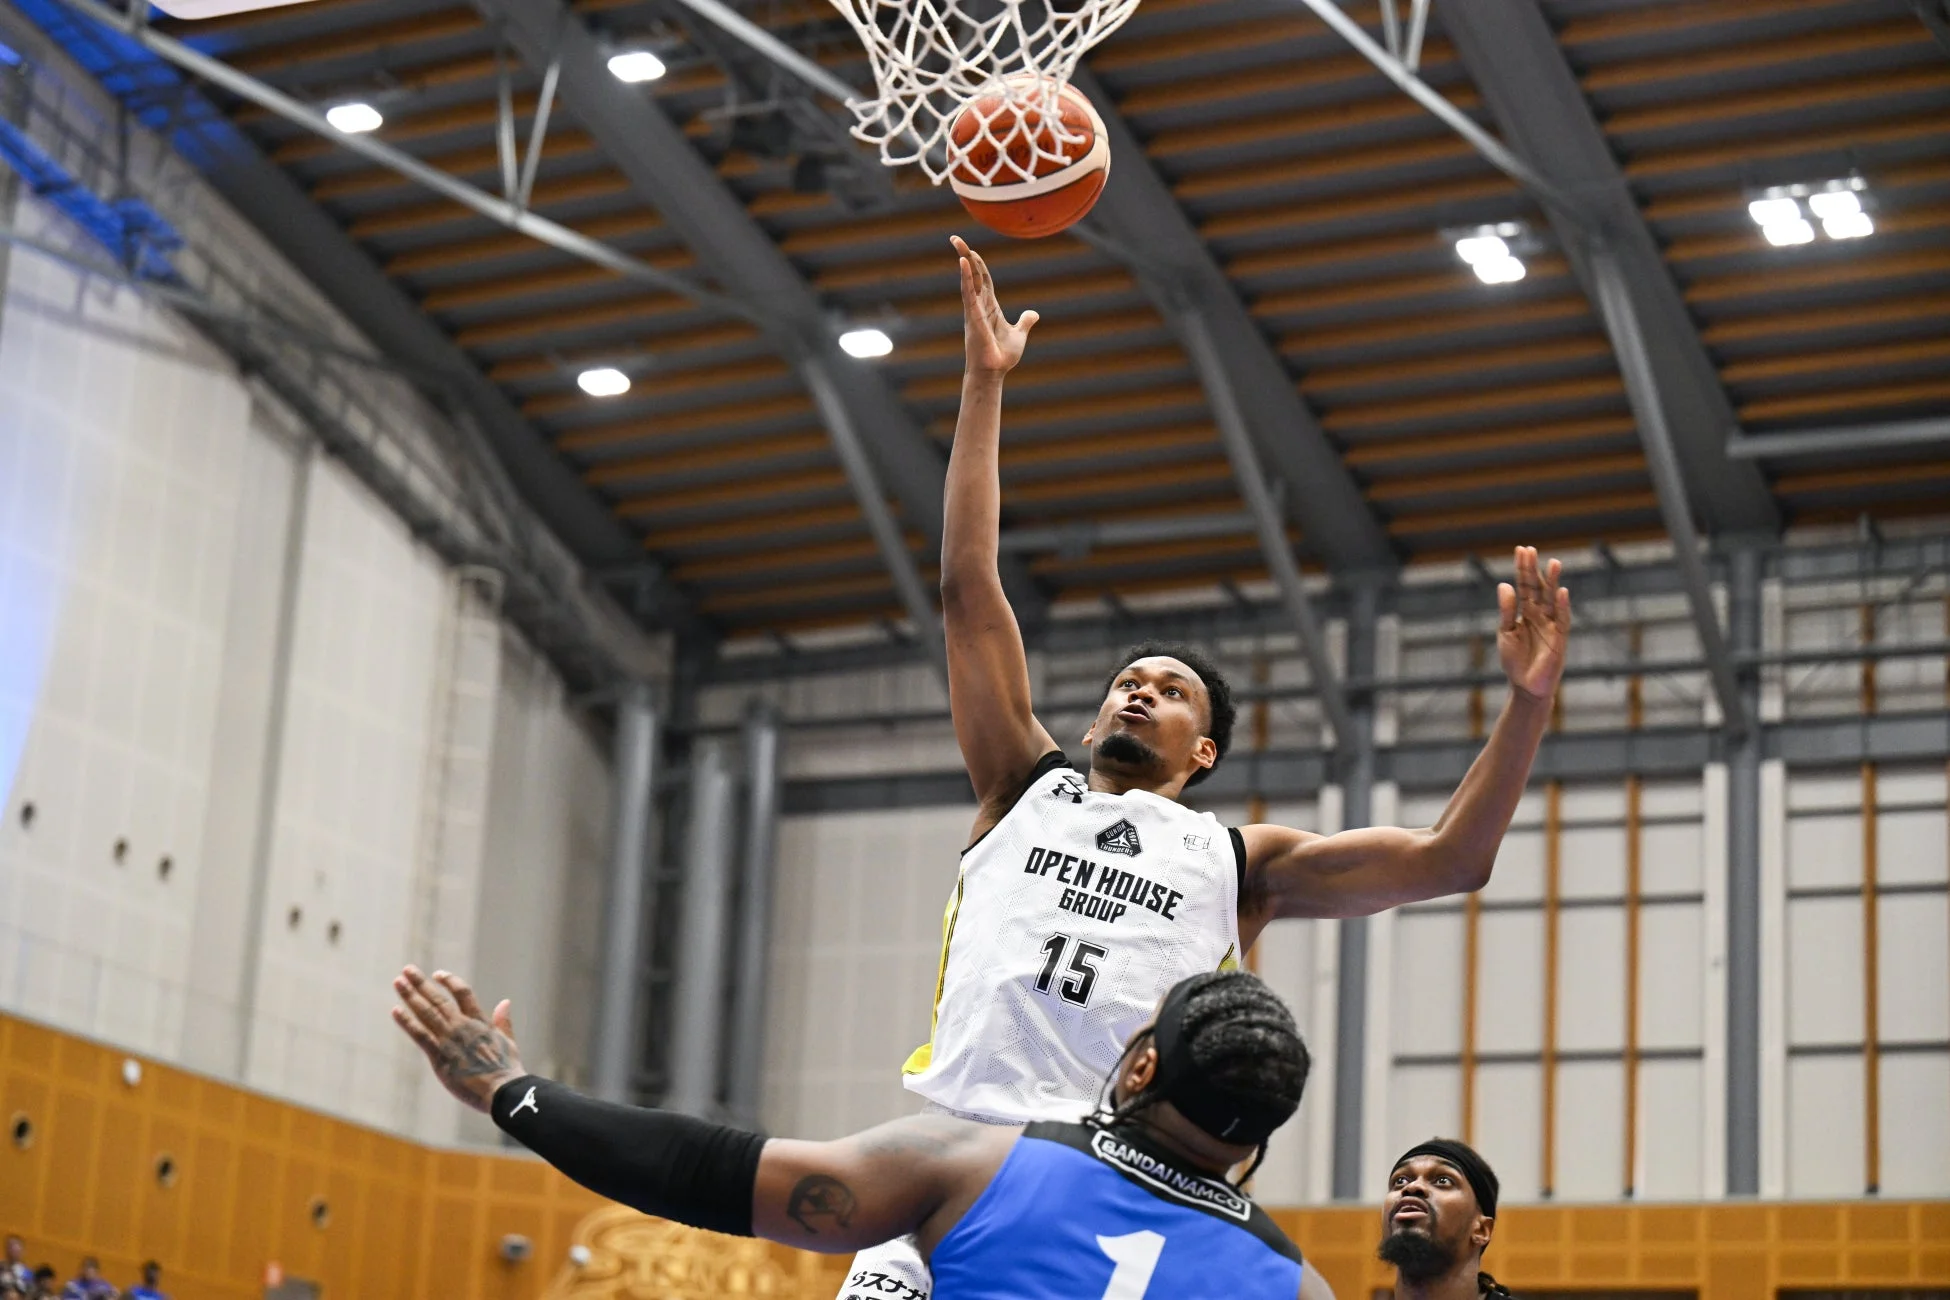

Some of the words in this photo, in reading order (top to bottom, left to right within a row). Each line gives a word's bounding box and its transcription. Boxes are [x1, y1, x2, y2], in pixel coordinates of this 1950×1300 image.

[1023, 846, 1096, 889] OPEN
[1095, 865, 1184, 922] HOUSE
[1057, 887, 1127, 924] GROUP
[1032, 931, 1109, 1009] 15
[1101, 1139, 1174, 1180] BANDAI
[1171, 1172, 1243, 1211] NAMCO
[1095, 1229, 1167, 1300] 1
